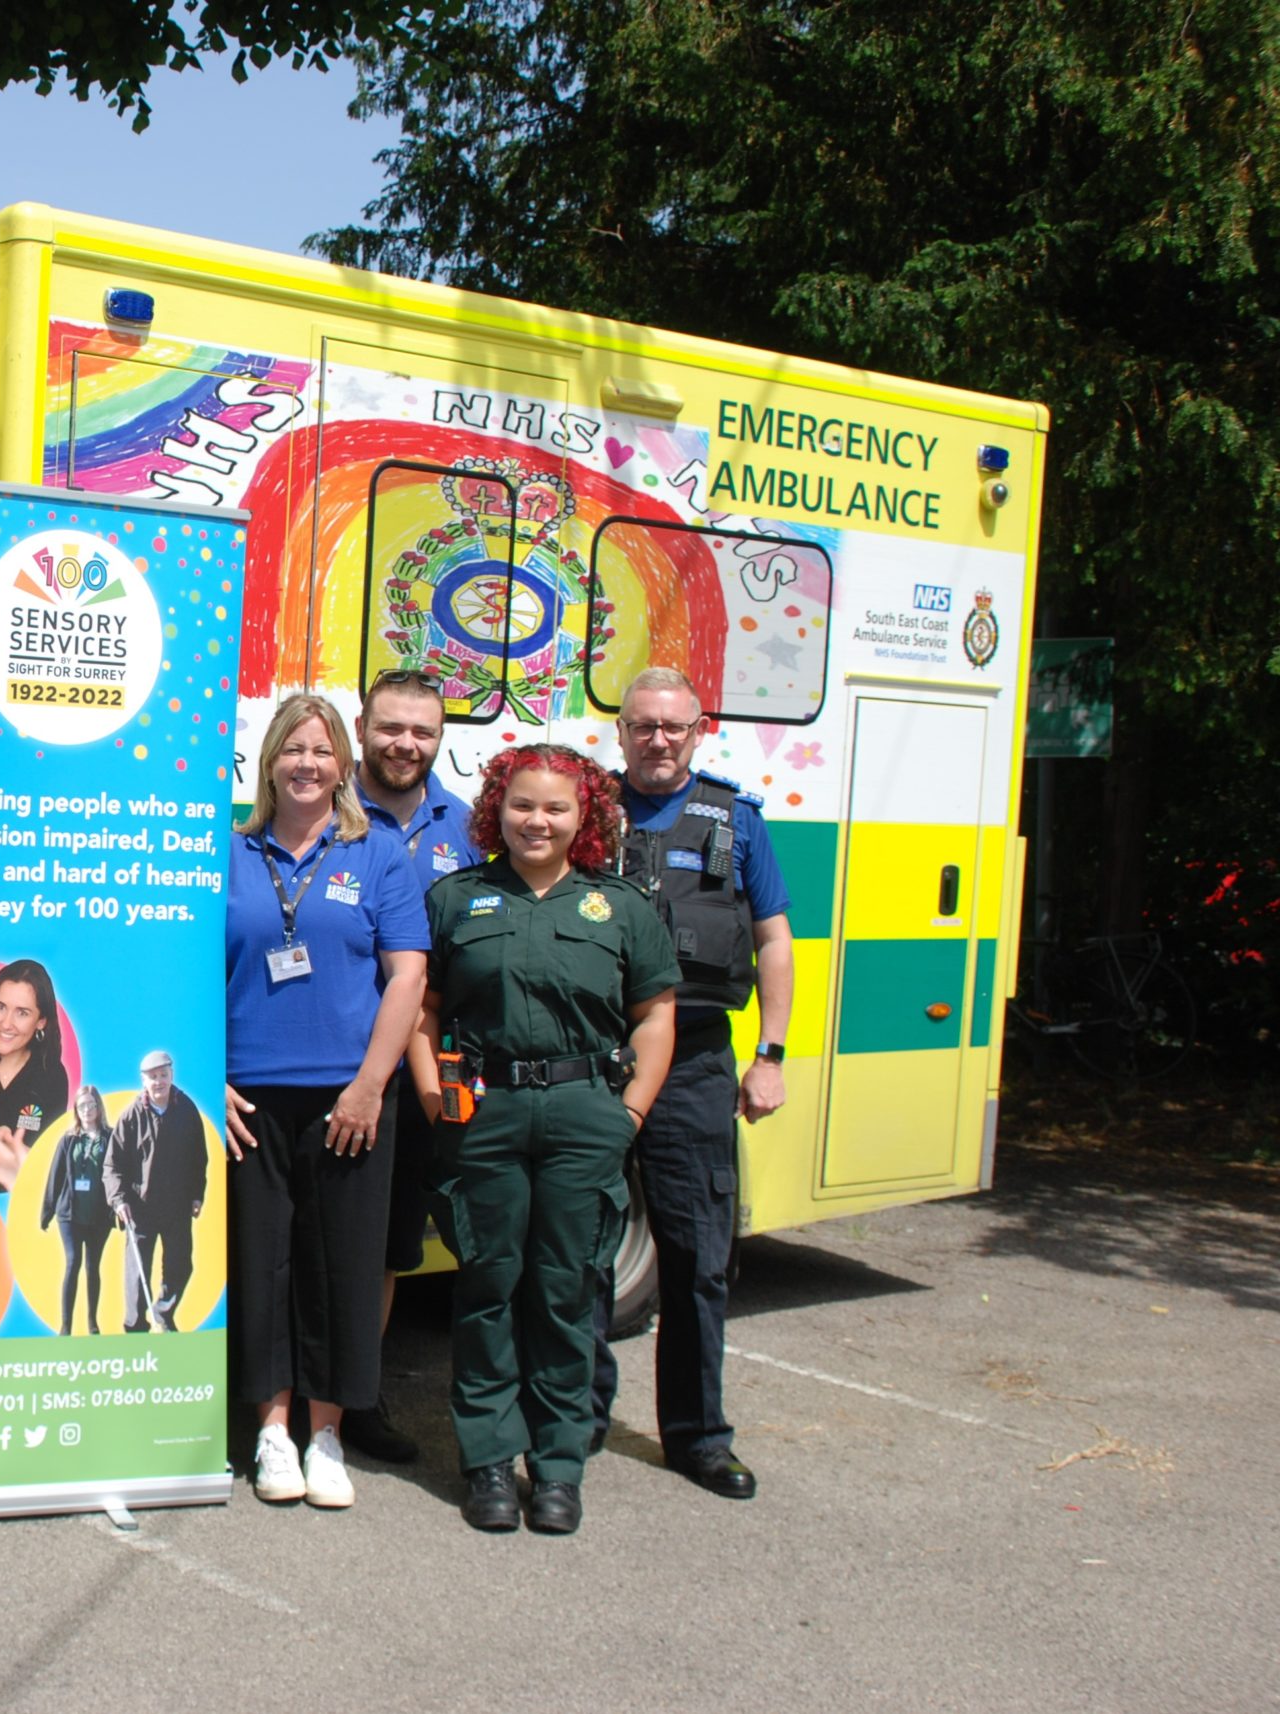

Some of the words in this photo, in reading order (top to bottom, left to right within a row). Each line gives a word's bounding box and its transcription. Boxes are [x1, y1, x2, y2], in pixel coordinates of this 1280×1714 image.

[433, 389, 600, 454] NHS
[718, 399, 939, 471] EMERGENCY
[709, 461, 941, 529] AMBULANCE
[41, 555, 107, 591] 100
[914, 585, 950, 611] NHS
[10, 607, 128, 635] SENSORY
[865, 609, 895, 626] South
[898, 613, 919, 629] East
[922, 616, 949, 632] Coast
[9, 630, 127, 658] SERVICES
[853, 627, 910, 646] Ambulance
[913, 632, 948, 649] Service
[8, 662, 43, 676] SIGHT
[46, 665, 70, 678] FOR
[74, 667, 126, 681] SURREY
[60, 656, 72, 665] BY
[10, 683, 122, 706] 1922-2022
[39, 791, 121, 820] people
[128, 794, 178, 817] who
[184, 800, 216, 819] are
[44, 825, 155, 854] impaired,
[163, 830, 217, 856] Deaf,
[3, 860, 45, 883] and
[53, 860, 106, 885] hard
[114, 862, 141, 885] of
[146, 862, 222, 893] hearing
[32, 894, 67, 918] for
[75, 897, 119, 920] 100
[126, 903, 195, 926] years.
[472, 896, 501, 909] NHS
[42, 1391, 86, 1410] SMS:
[91, 1388, 146, 1407] 07860
[151, 1384, 215, 1405] 026269
